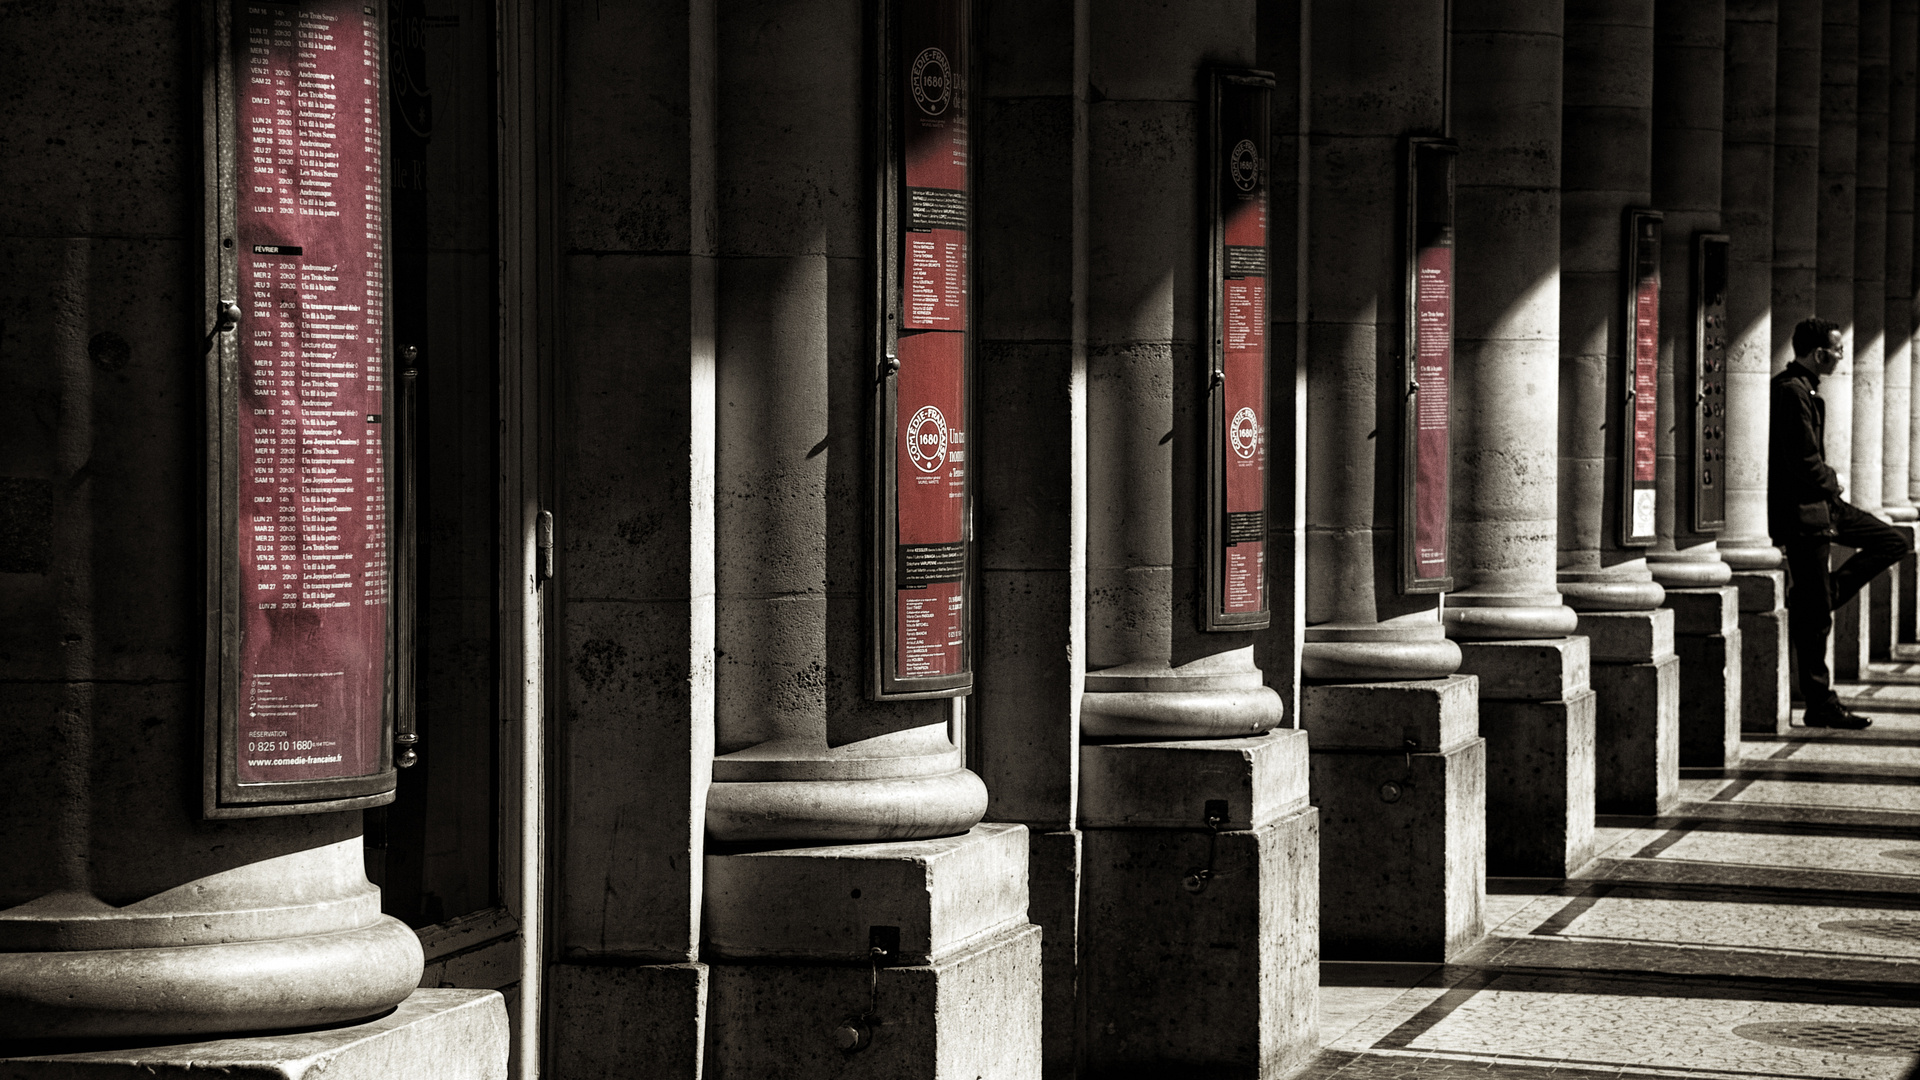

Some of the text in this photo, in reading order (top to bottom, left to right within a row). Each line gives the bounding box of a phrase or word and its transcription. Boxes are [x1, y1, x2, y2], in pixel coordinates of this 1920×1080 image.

[923, 75, 943, 88] 1680
[298, 90, 309, 98] Les
[253, 136, 266, 144] MER
[255, 245, 278, 253] FÉVRIER
[909, 408, 947, 462] COMÉDIE-FRANÇAISE
[1239, 428, 1253, 438] 1680
[919, 434, 938, 445] 1680
[248, 740, 313, 752] 0 825 10 1680
